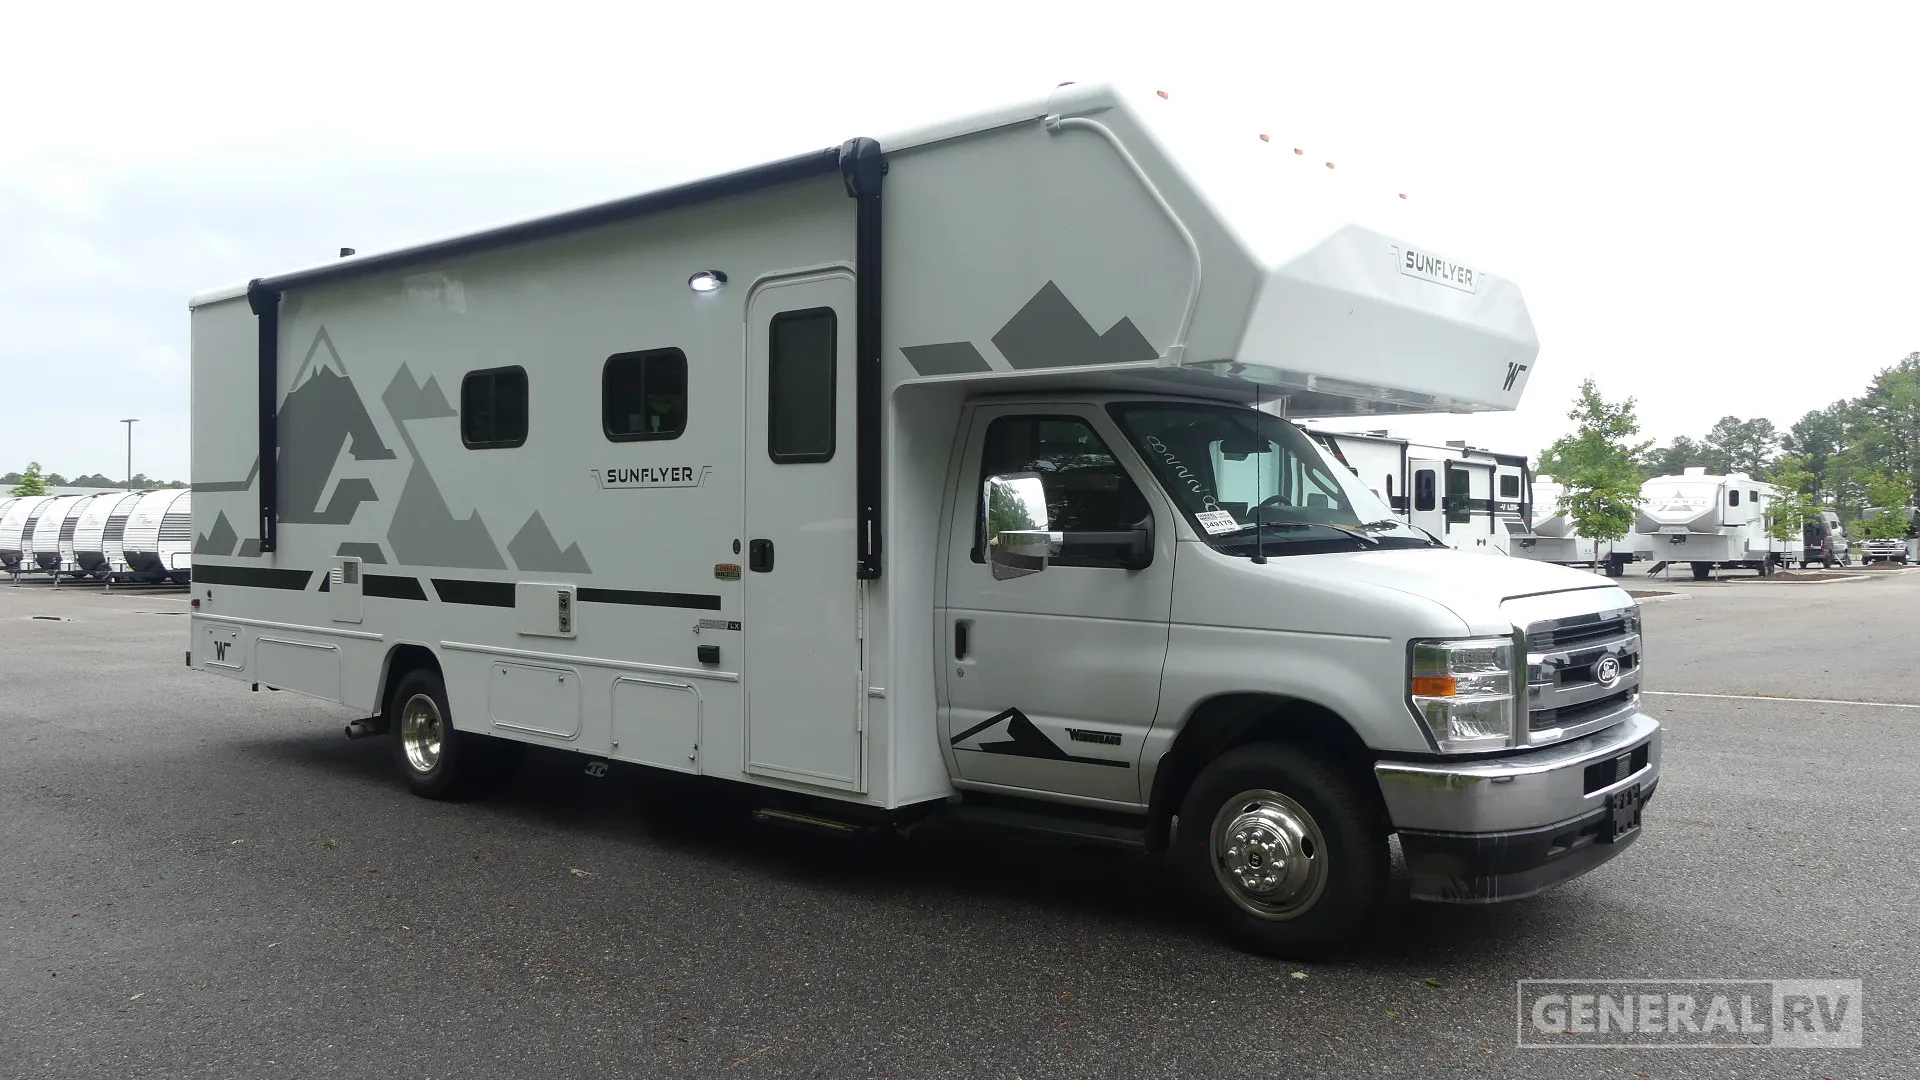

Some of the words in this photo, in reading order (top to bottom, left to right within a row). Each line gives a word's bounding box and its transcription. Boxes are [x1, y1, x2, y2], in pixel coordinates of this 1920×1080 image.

[1405, 250, 1473, 287] SUNFLYER
[607, 466, 693, 483] SUNFLYER
[1601, 661, 1617, 680] Ford
